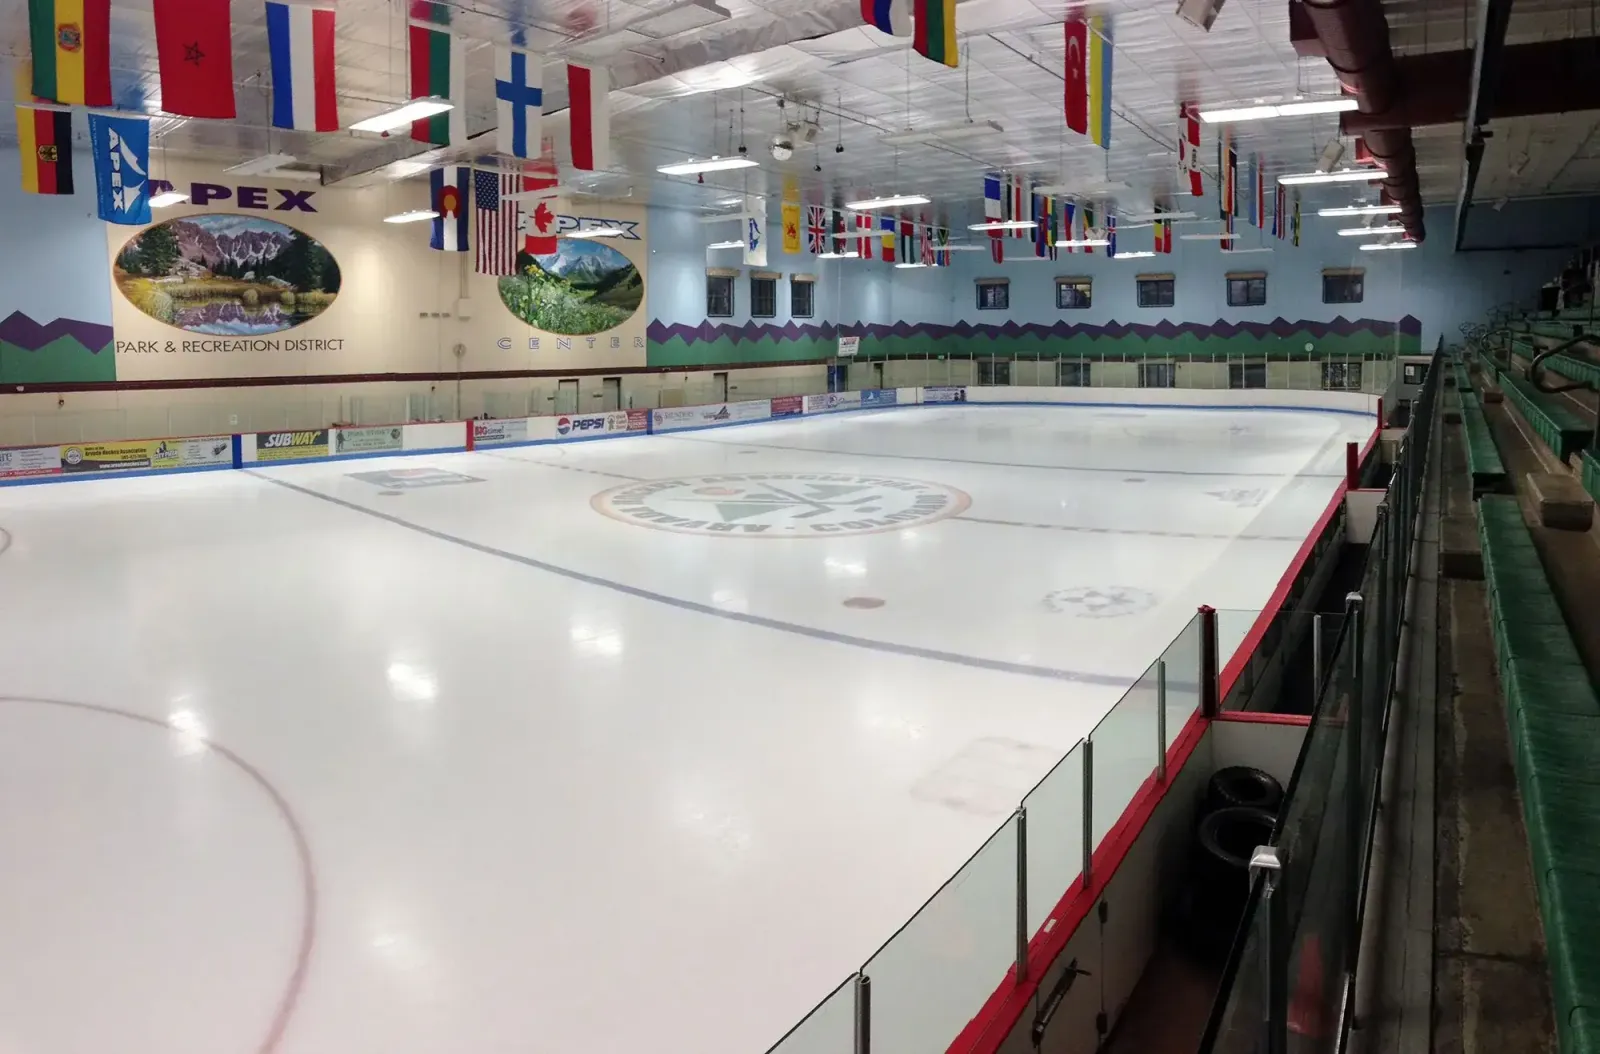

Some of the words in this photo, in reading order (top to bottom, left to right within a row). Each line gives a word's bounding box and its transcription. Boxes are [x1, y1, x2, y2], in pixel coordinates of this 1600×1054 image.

[108, 127, 124, 212] APEX
[116, 340, 159, 354] PARK
[164, 340, 177, 353] &
[182, 339, 280, 353] RECREATION
[284, 338, 345, 352] DISTRICT
[497, 336, 645, 350] CENTER
[571, 417, 605, 431] PEPSI
[265, 430, 322, 448] SUBWAY
